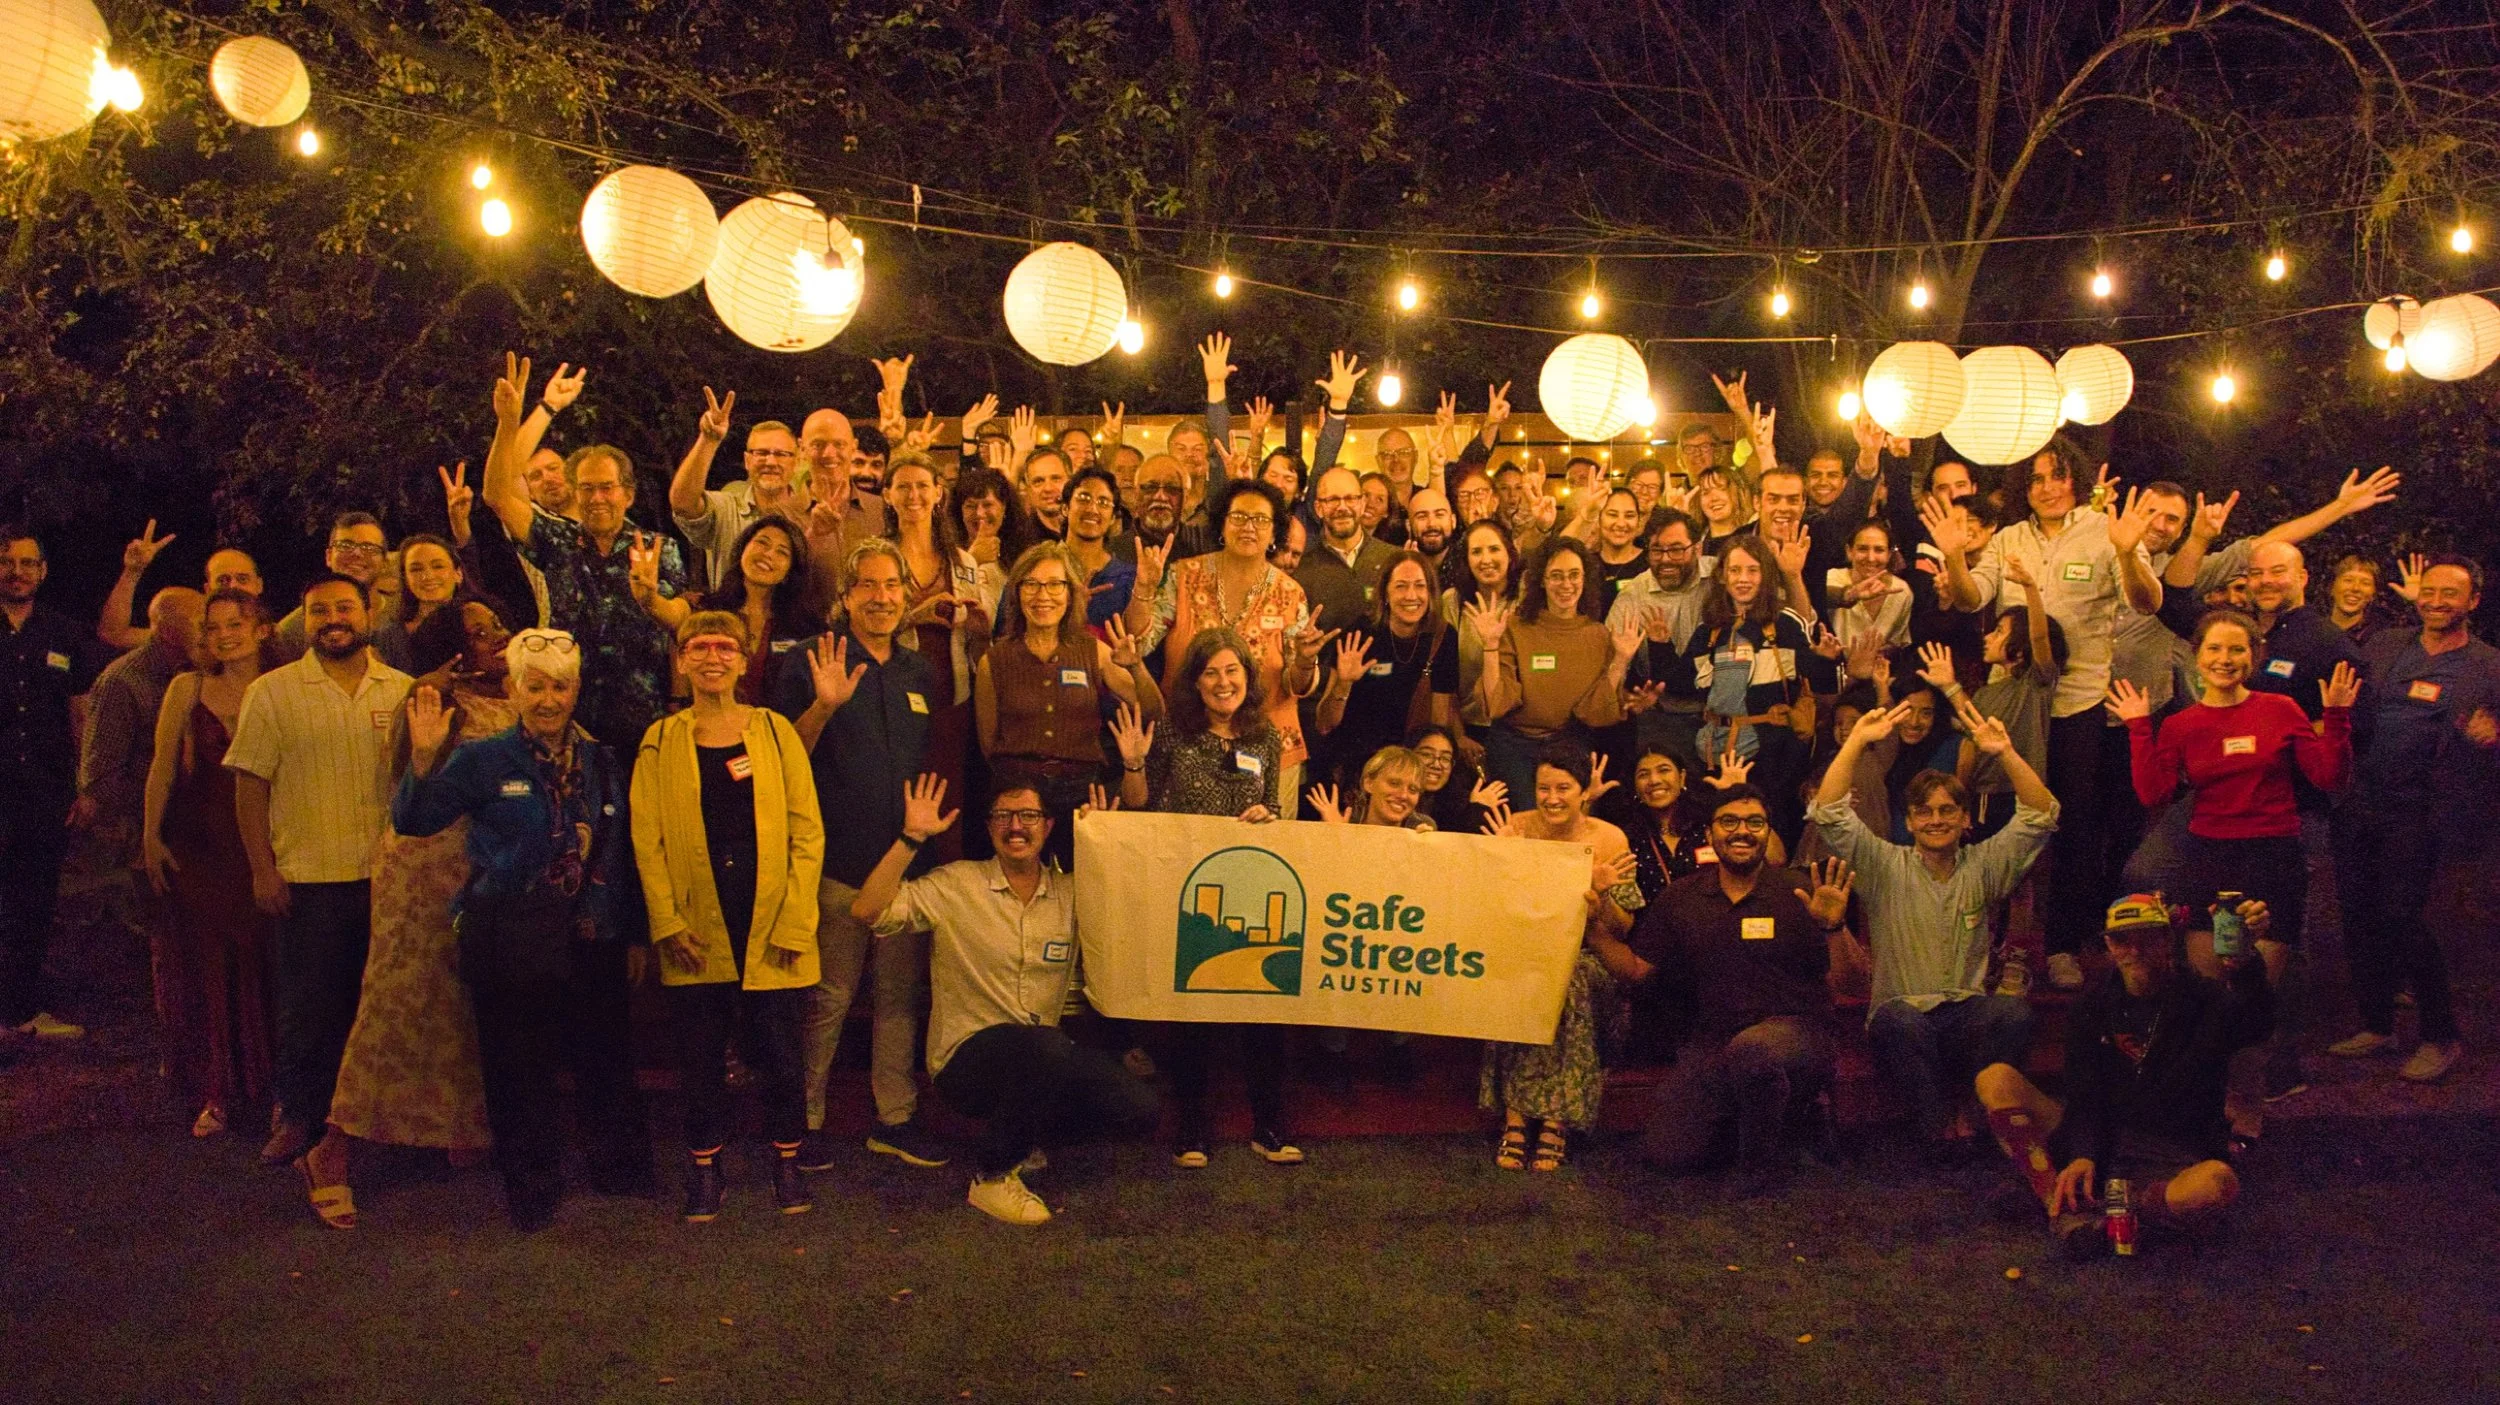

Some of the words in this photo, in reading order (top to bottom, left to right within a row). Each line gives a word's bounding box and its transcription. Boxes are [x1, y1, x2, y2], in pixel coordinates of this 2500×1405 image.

[1324, 892, 1425, 933] Safe
[1320, 932, 1485, 979] Streets
[1319, 973, 1422, 997] AUSTIN
